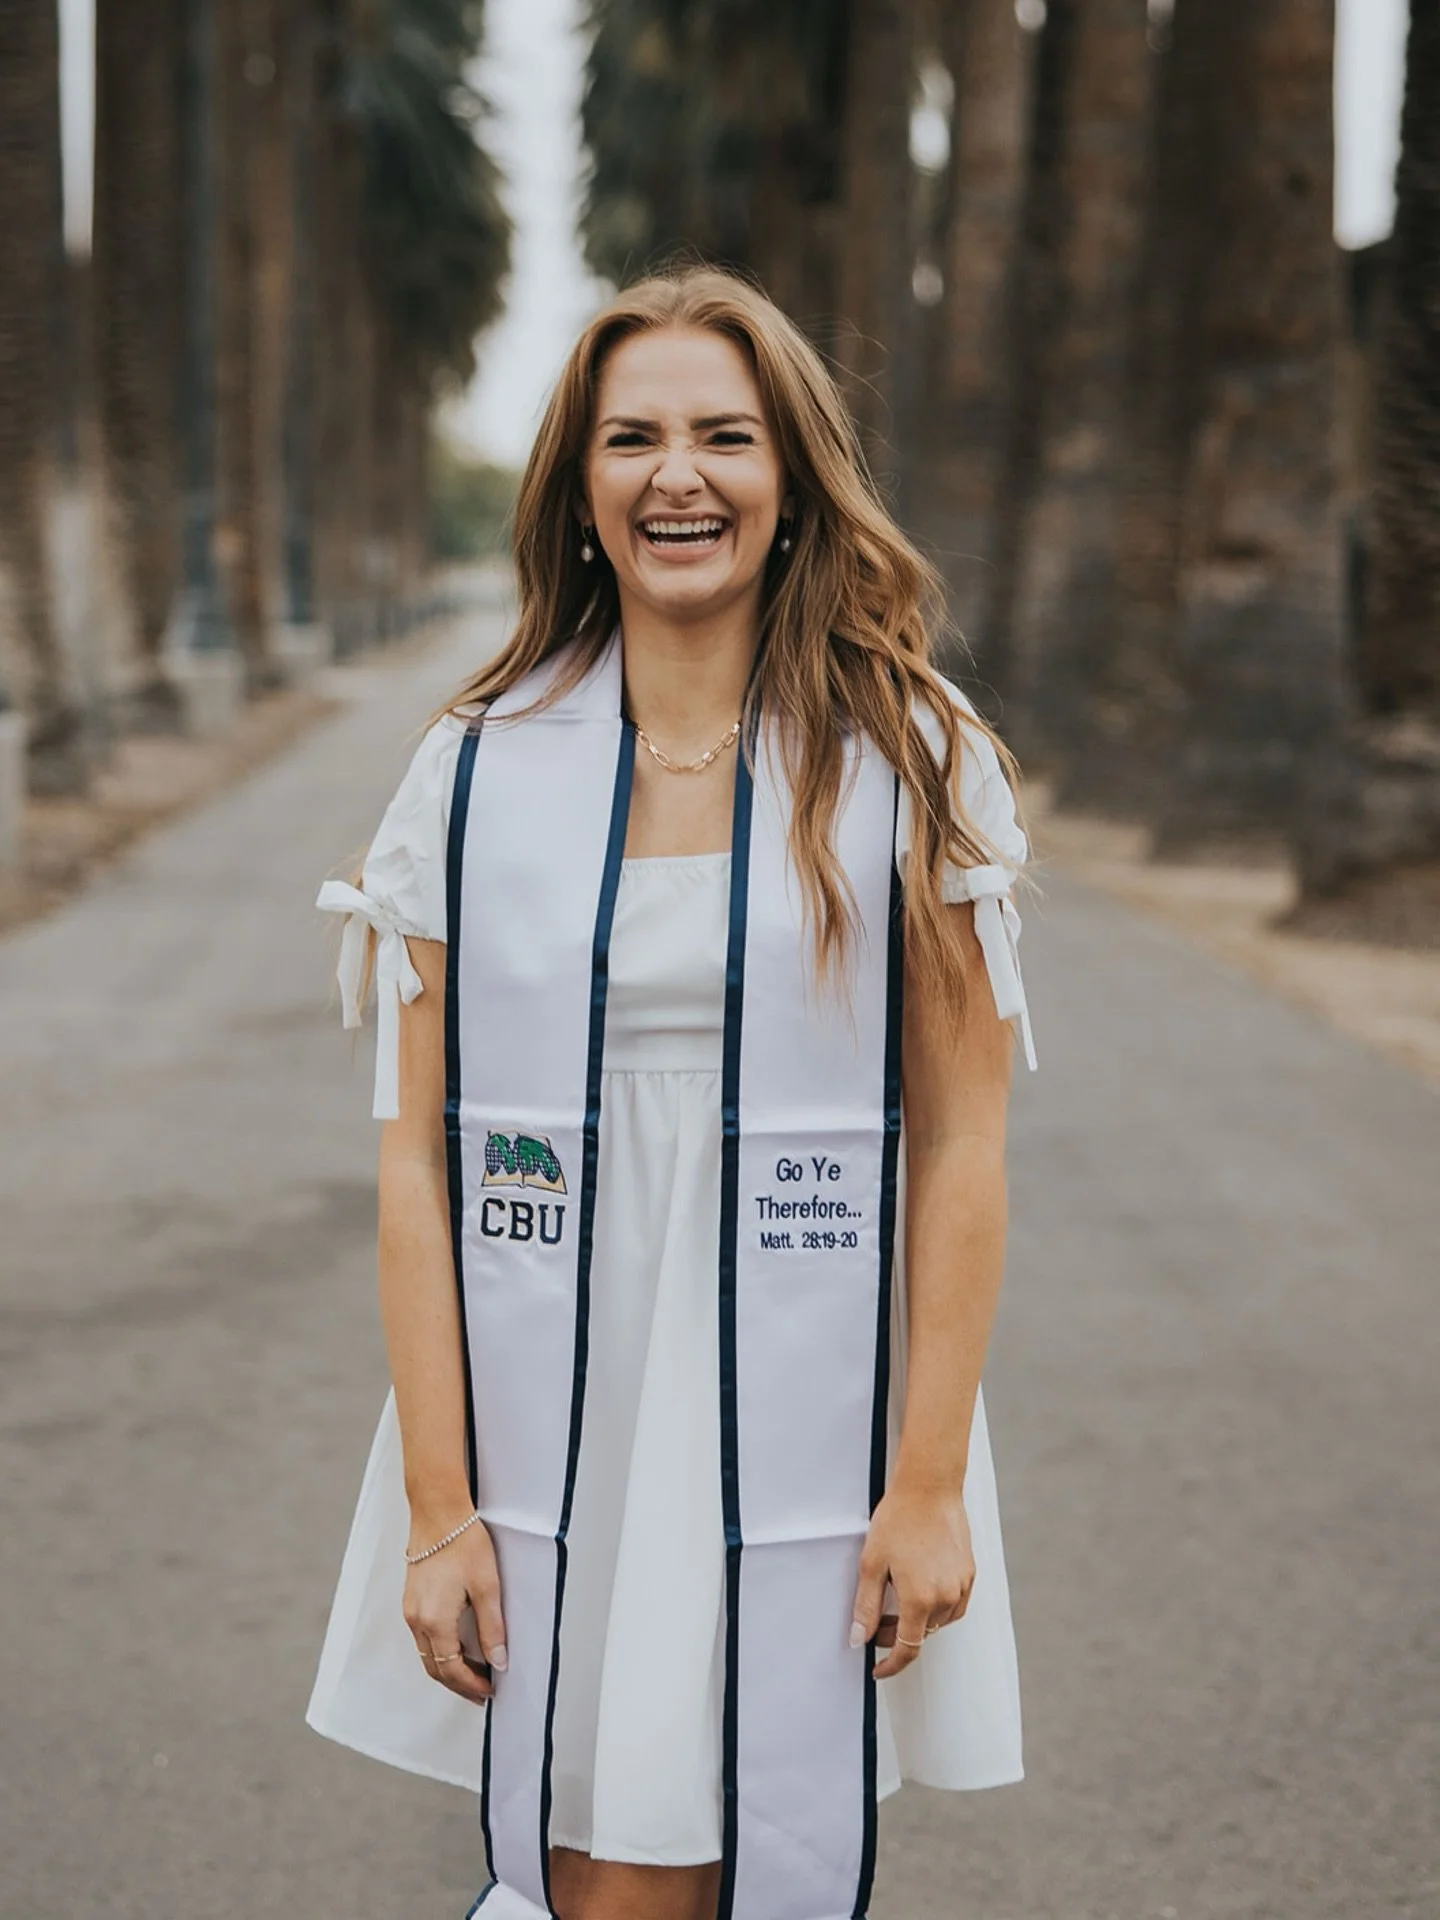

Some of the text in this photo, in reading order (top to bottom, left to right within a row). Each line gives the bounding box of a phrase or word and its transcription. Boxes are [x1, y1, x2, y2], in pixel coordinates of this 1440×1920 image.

[776, 1157, 841, 1182] Go Ye
[755, 1194, 862, 1219] Therefore...
[480, 1197, 565, 1245] CBU
[760, 1231, 858, 1249] Matt. 28:19-20
